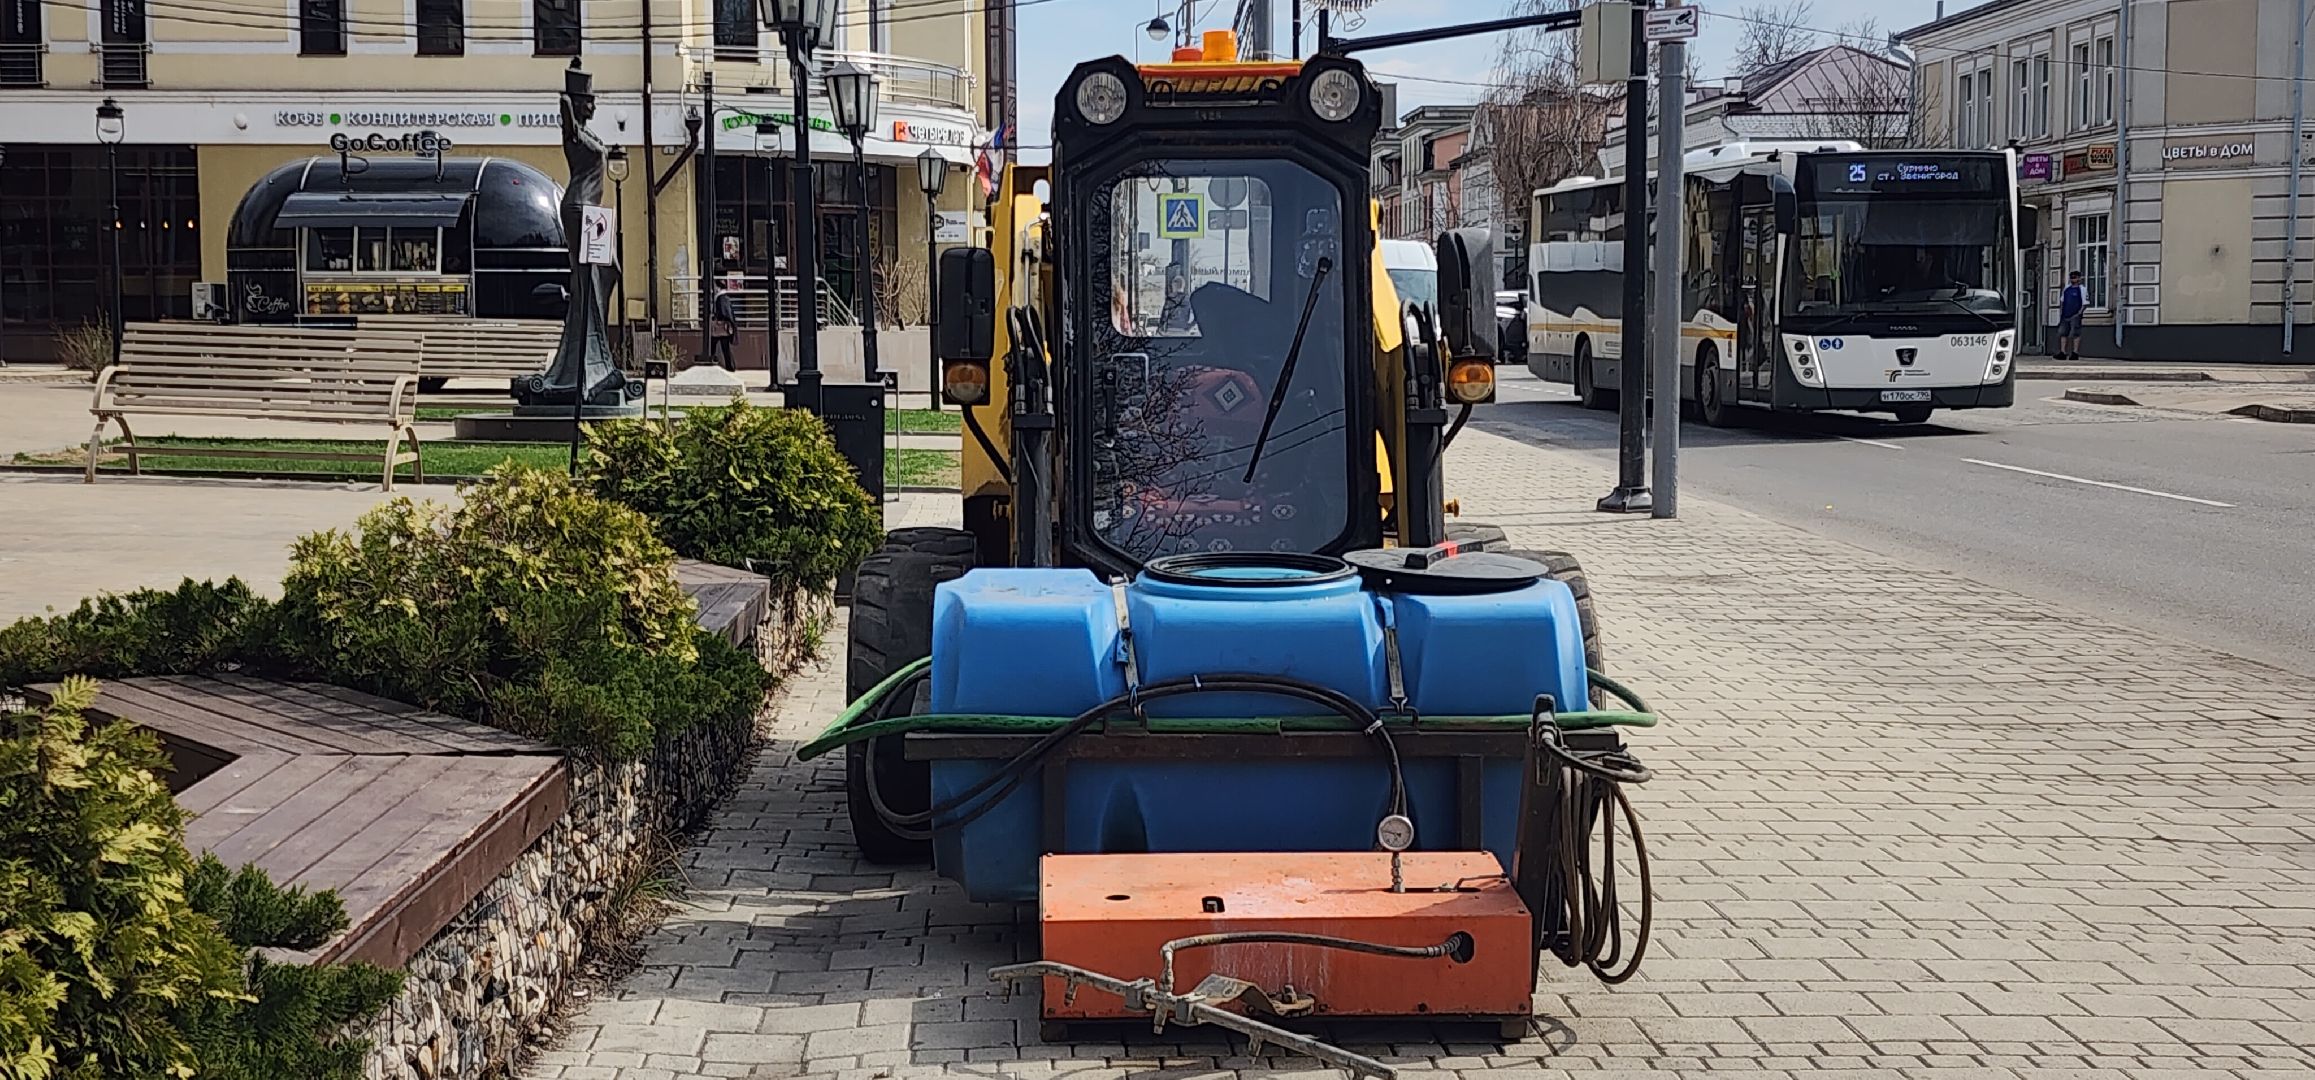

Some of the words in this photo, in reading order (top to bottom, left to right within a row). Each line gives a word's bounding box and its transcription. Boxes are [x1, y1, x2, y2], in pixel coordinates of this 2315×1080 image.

[275, 111, 324, 127] КОФЕ
[345, 111, 496, 128] КОНДИТЕРСКАЯ
[517, 112, 562, 128] ПИЦ
[330, 132, 452, 151] GoCoffee
[2026, 155, 2049, 163] ЦВЕТЫ
[2162, 144, 2207, 160] ЦВЕТЫ
[2219, 143, 2254, 159] ДОМ
[1849, 164, 1866, 182] 25
[2029, 167, 2046, 176] ДОМ
[259, 295, 291, 315] Coffee
[1950, 336, 1988, 347] 063146
